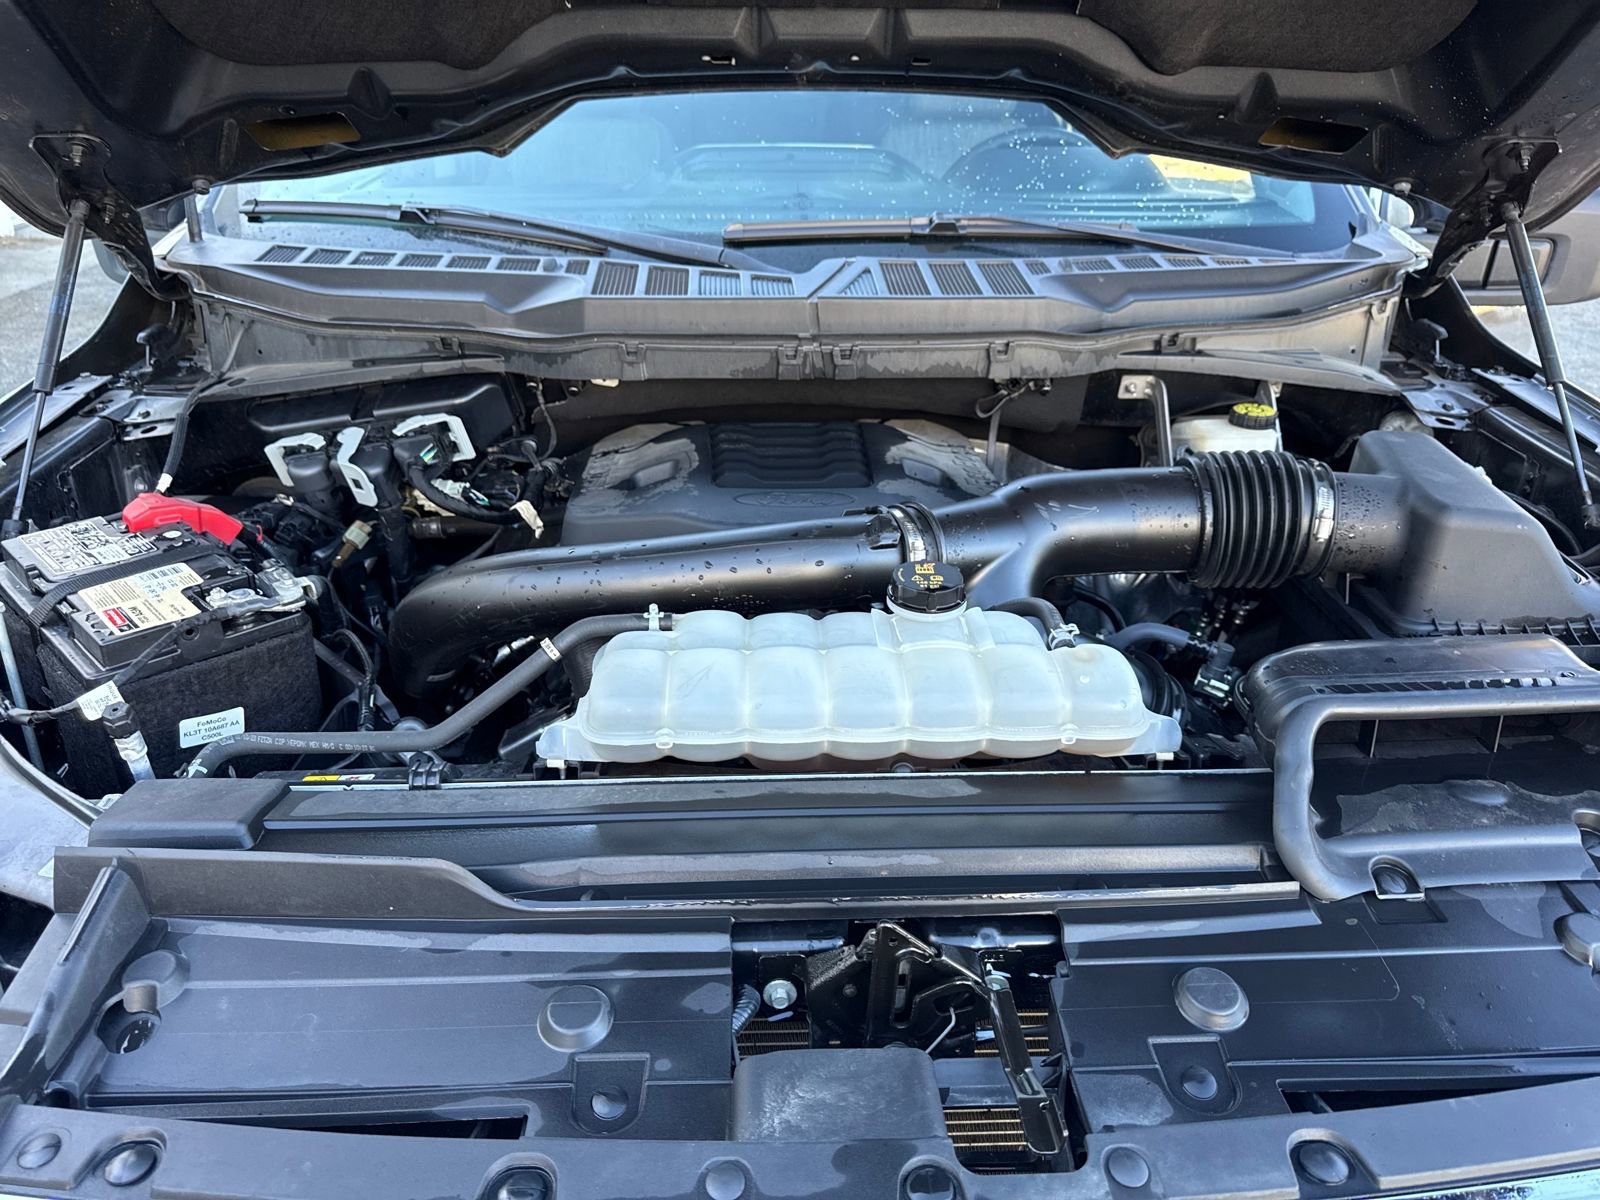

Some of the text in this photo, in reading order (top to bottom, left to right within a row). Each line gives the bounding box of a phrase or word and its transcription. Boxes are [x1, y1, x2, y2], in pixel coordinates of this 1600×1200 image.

[183, 728, 204, 738] KL3T
[229, 719, 240, 727] AA
[197, 716, 227, 728] FoMoCo
